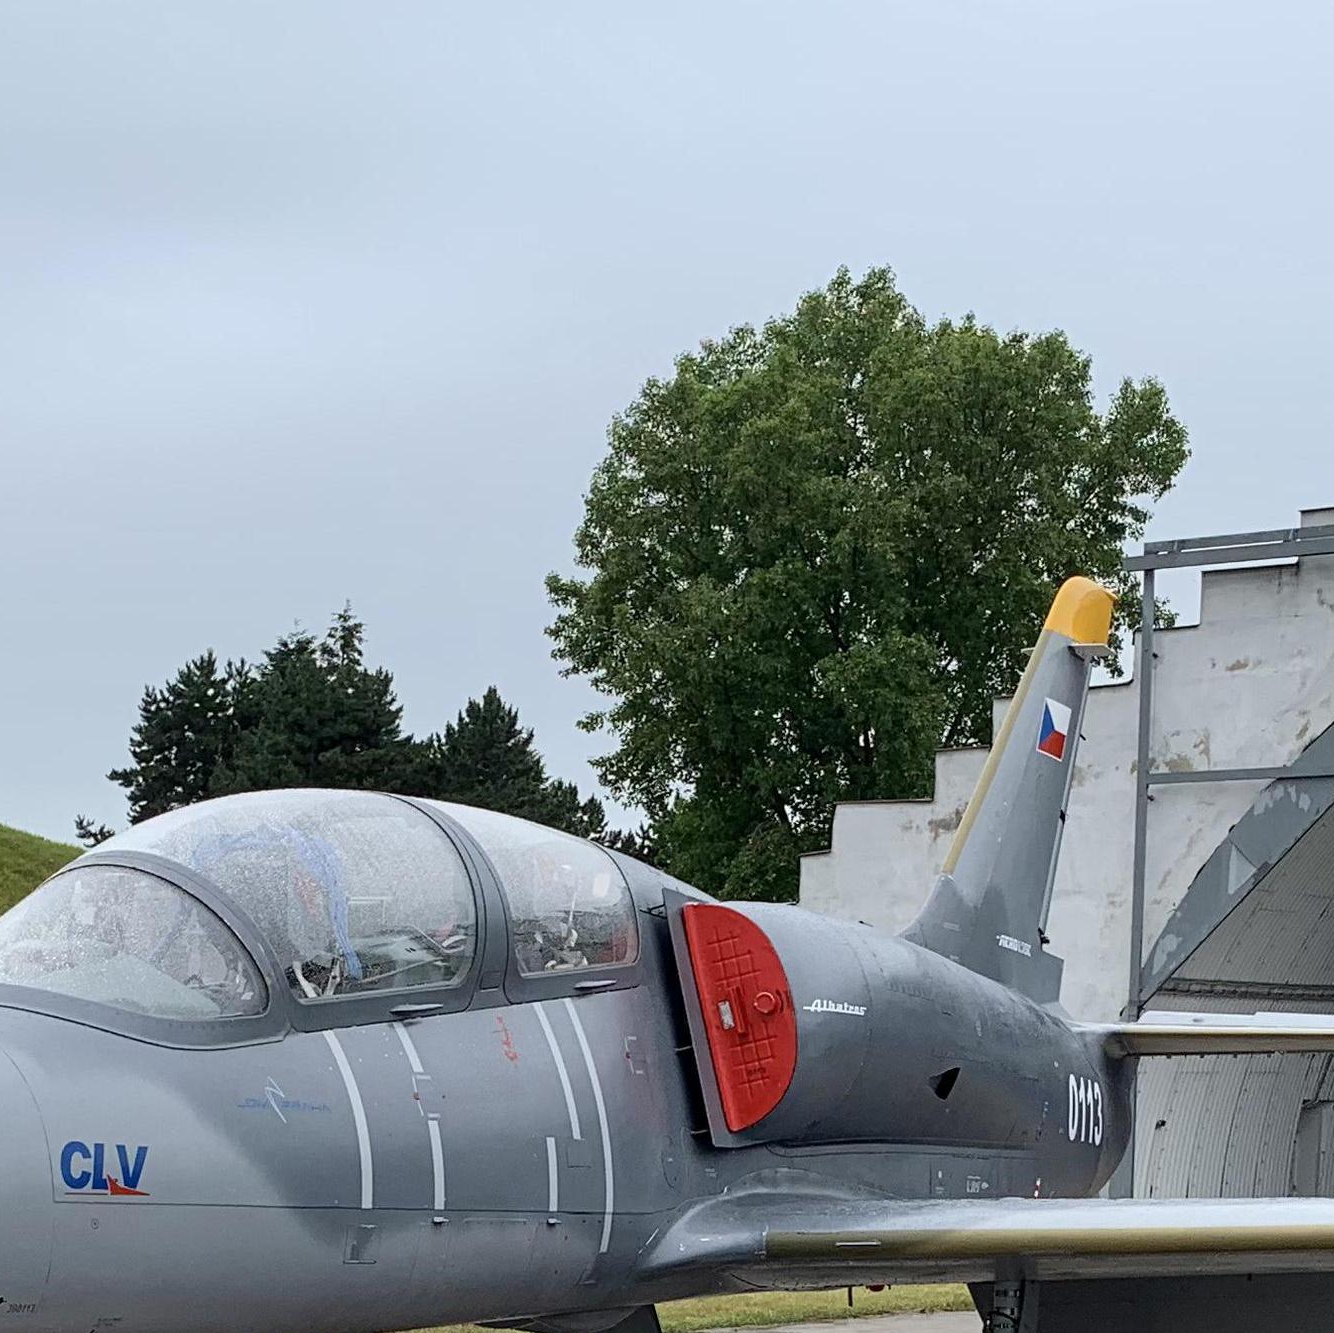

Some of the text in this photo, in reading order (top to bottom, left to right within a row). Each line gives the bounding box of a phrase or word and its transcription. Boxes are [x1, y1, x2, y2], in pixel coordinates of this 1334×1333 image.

[803, 999, 867, 1016] Albatros
[1069, 1074, 1102, 1146] 0113
[61, 1141, 148, 1190] CLV
